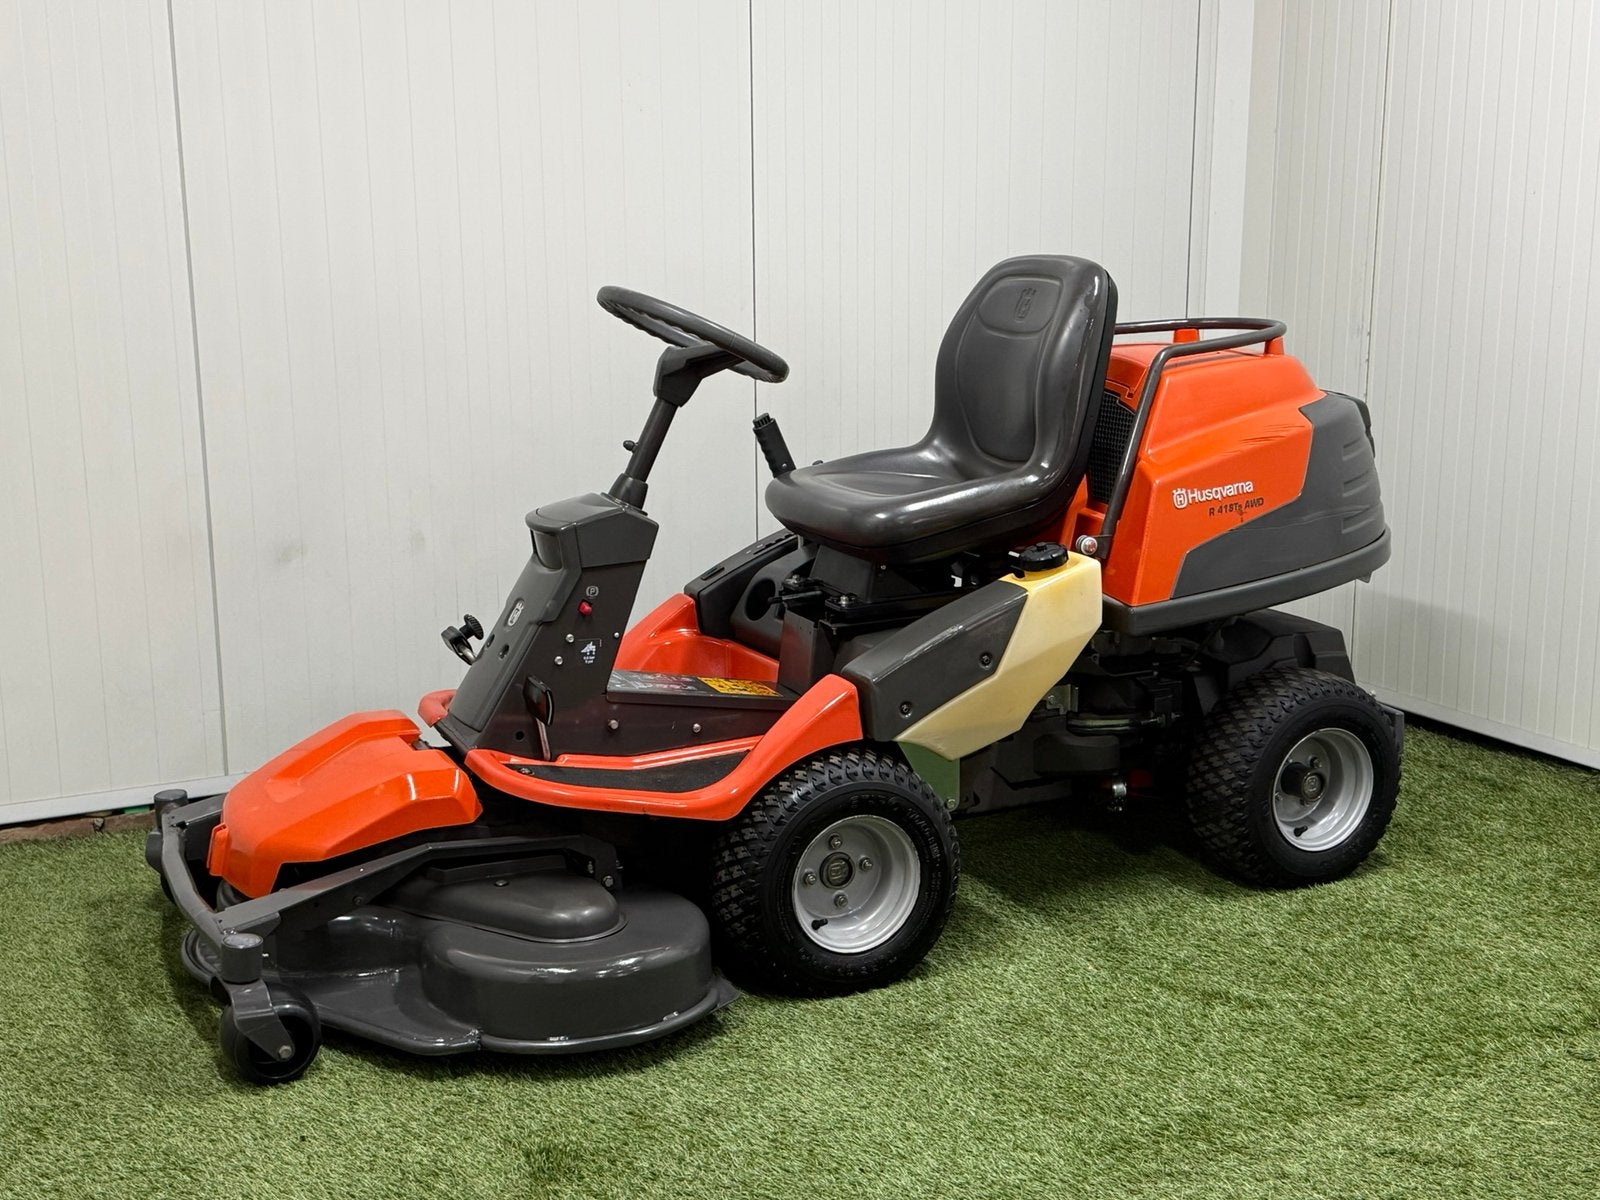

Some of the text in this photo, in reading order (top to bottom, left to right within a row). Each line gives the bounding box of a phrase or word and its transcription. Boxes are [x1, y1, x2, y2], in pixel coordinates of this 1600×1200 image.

[1187, 480, 1254, 504] Husqvarna
[1208, 507, 1215, 517] R
[1244, 497, 1264, 509] AWD
